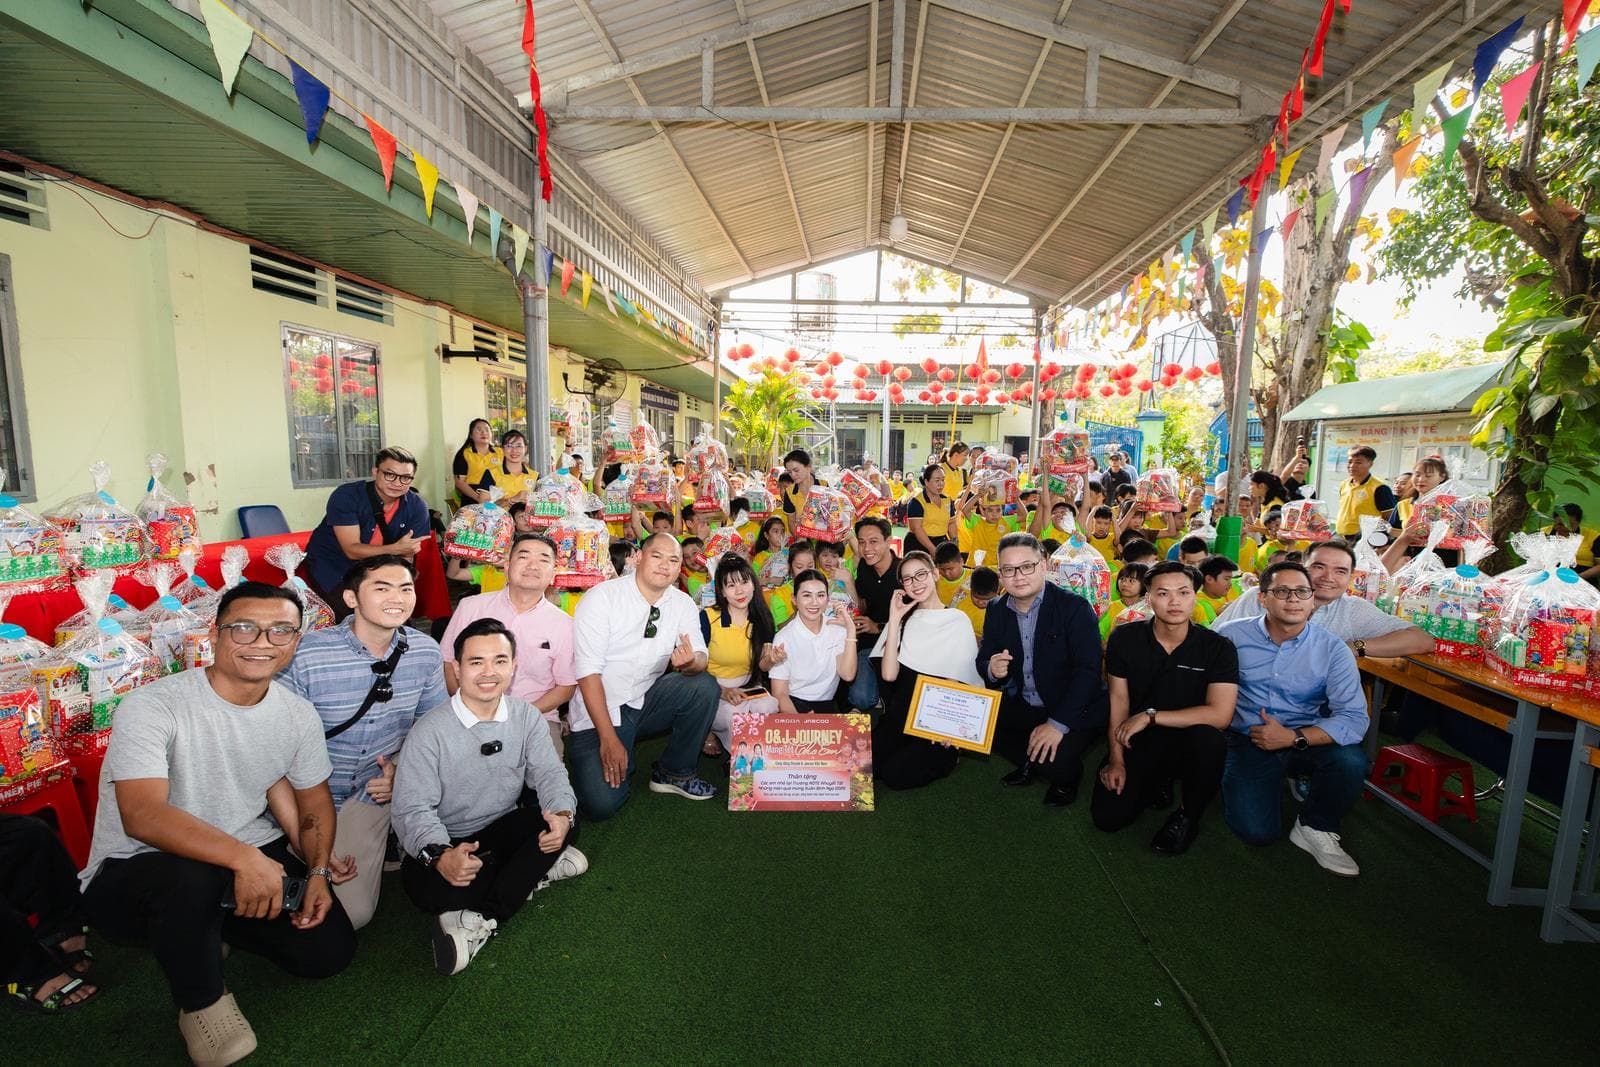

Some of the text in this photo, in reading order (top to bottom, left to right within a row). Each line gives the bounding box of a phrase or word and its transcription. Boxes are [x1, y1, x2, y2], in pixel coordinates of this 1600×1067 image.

[1439, 644, 1455, 654] PIE
[1553, 679, 1567, 687] PIE
[765, 729, 843, 745] O&J JOURNEY
[26, 777, 42, 791] PIE
